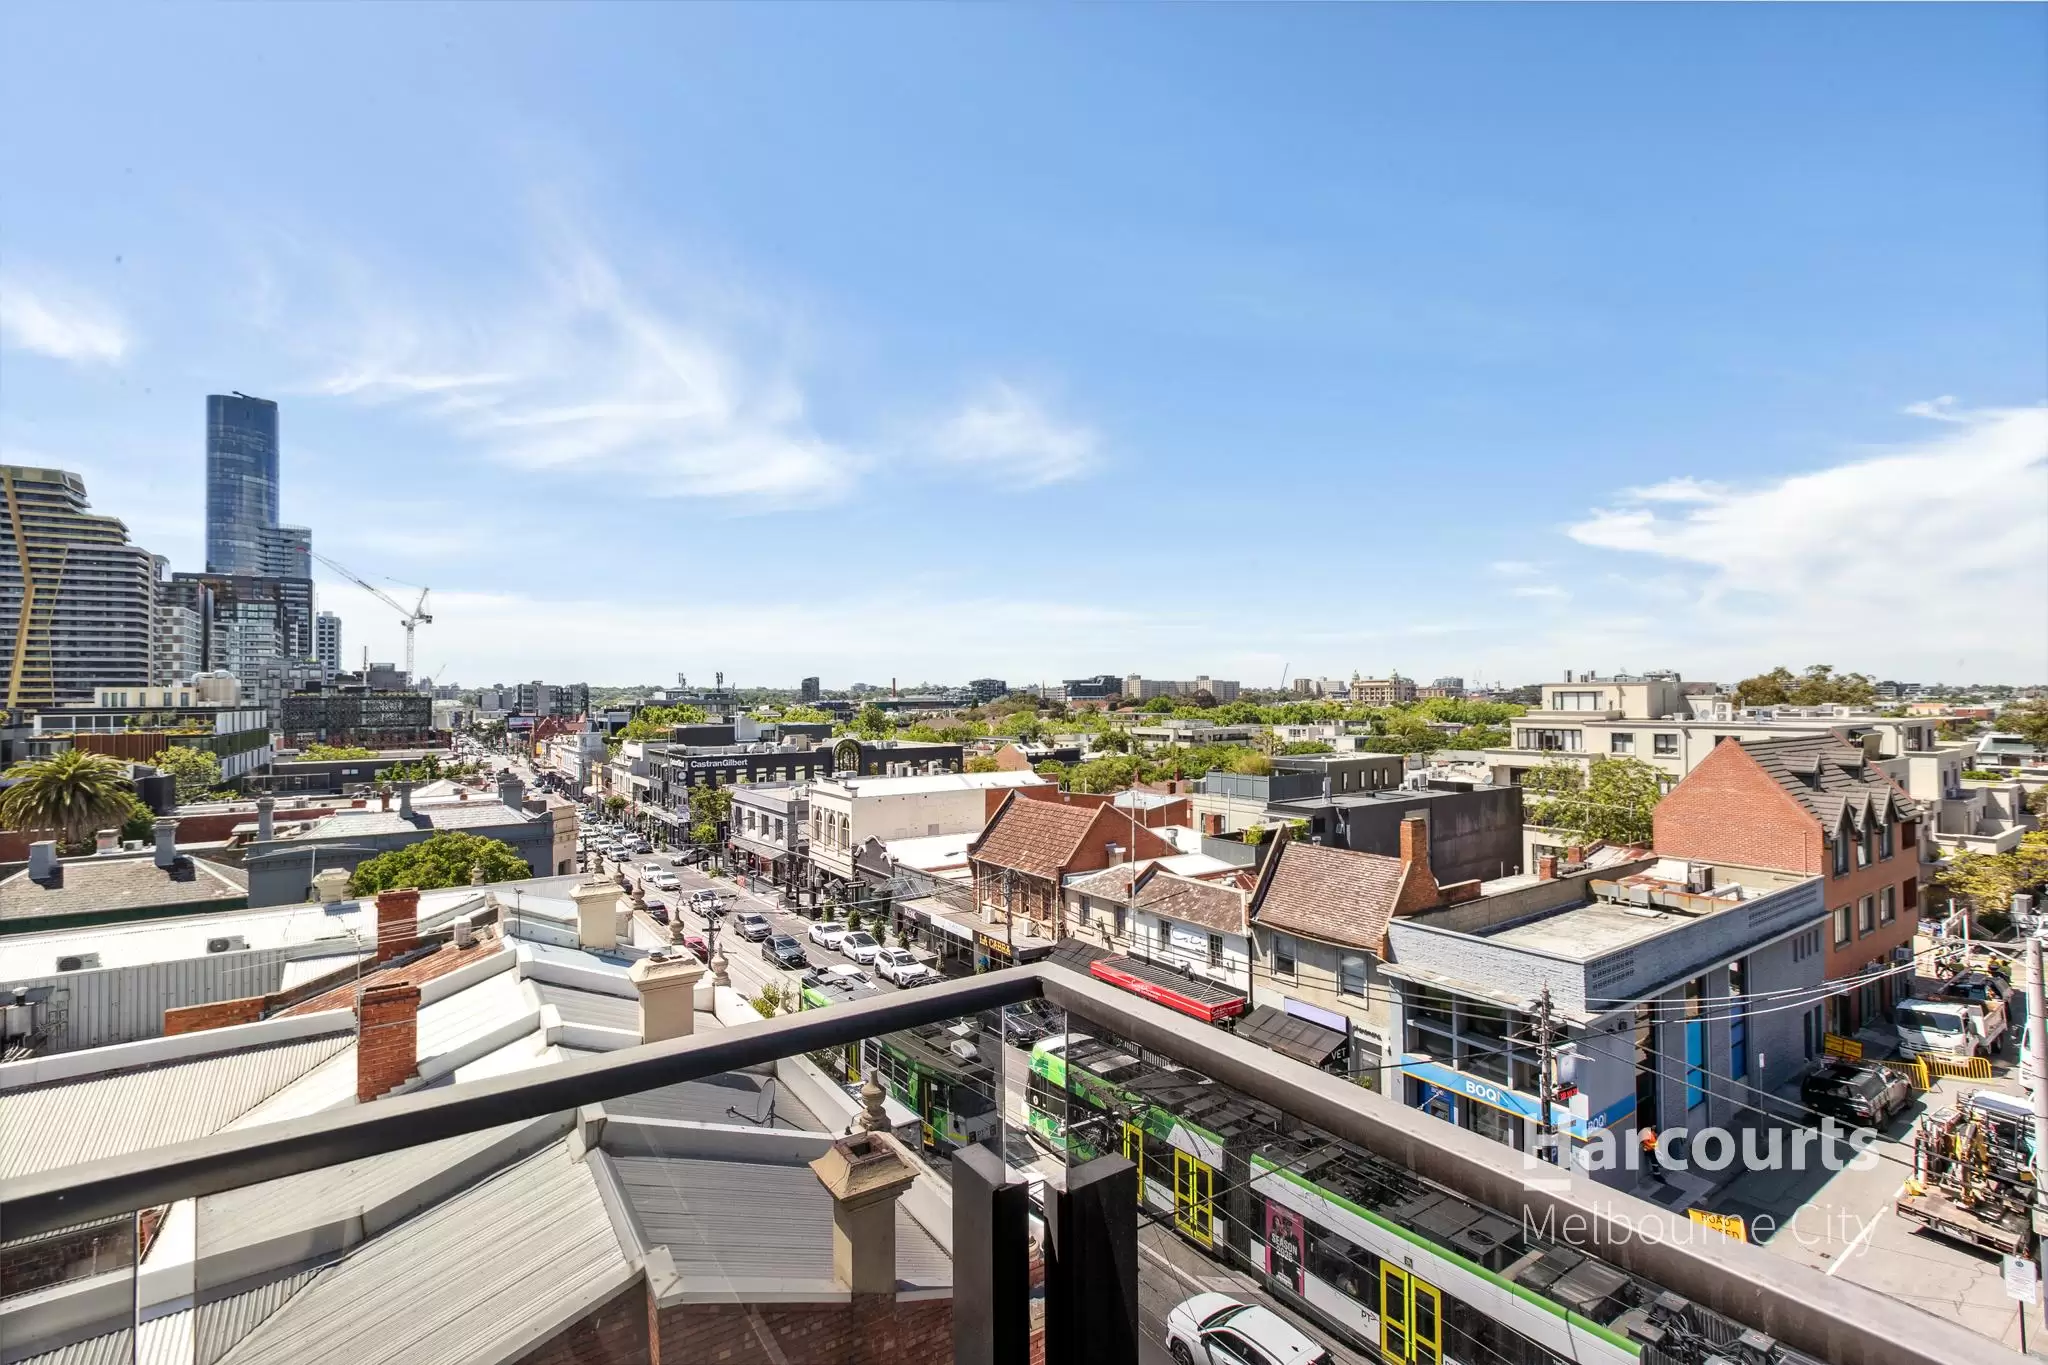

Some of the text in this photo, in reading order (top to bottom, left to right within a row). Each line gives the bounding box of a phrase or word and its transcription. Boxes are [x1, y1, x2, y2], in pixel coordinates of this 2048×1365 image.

[690, 759, 748, 768] CastranGilbert
[1331, 1047, 1347, 1060] VET
[1465, 1080, 1496, 1102] BOQ
[1587, 1114, 1605, 1134] BOQ
